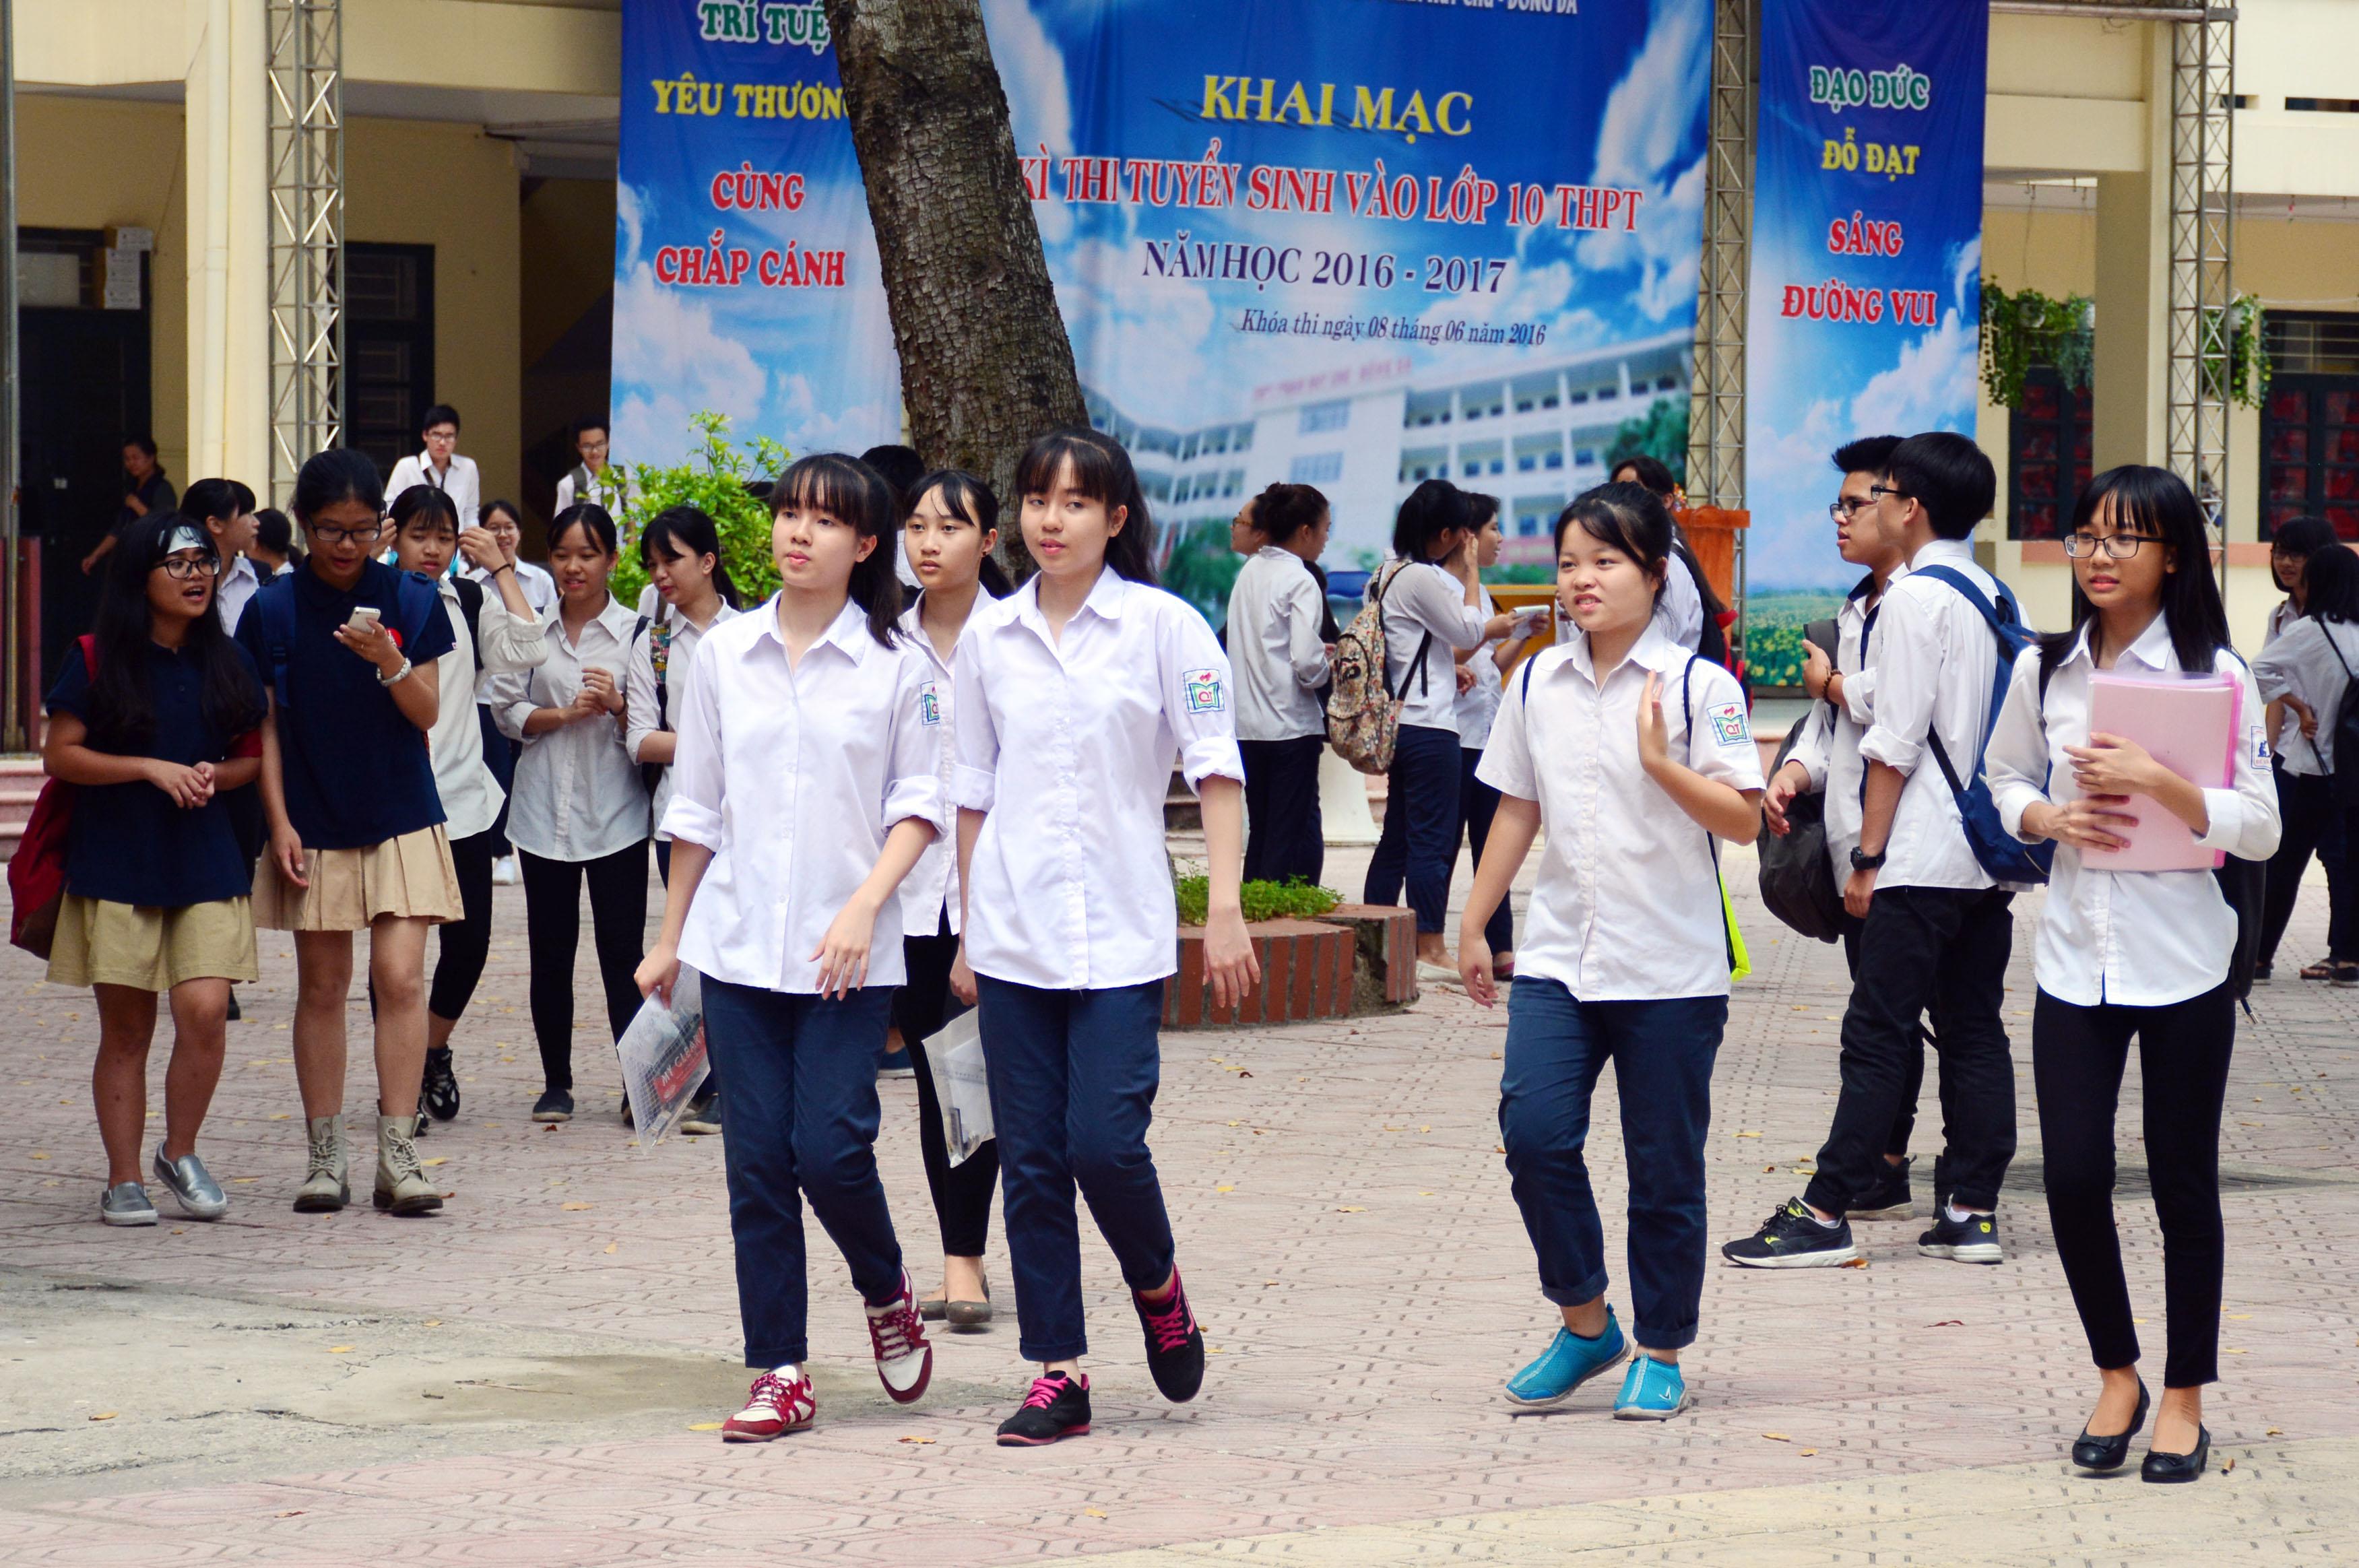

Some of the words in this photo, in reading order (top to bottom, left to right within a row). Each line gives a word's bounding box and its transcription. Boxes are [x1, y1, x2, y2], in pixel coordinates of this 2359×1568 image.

[651, 71, 723, 116] YÊU
[732, 80, 849, 120] THƯƠN
[1200, 75, 1336, 126] KHAI
[1349, 85, 1473, 144] MẠC
[1811, 67, 1866, 112] ĐẠO
[1871, 65, 1929, 109] ĐỨC
[1821, 127, 1859, 171] ĐỖ
[1865, 143, 1920, 182] ĐẠT
[711, 162, 805, 211] CÙNG
[1060, 156, 1120, 202] THI
[1126, 137, 1241, 207] TUYỂN
[1248, 165, 1336, 213] SINH
[1345, 158, 1418, 219] VÀO
[1425, 163, 1498, 224] LỚP
[1507, 183, 1545, 226] 10
[1554, 185, 1644, 232] THPT
[655, 228, 751, 286] CHẮP
[758, 240, 846, 287] CÁNH
[1828, 211, 1904, 257] SÁNG
[1142, 230, 1216, 279] NĂM
[1221, 244, 1301, 291] HỌC
[1312, 251, 1395, 289] 2016
[1424, 257, 1508, 294] 2017
[1781, 279, 1883, 323] ĐƯỜNG
[1889, 289, 1937, 325] VUI
[1241, 308, 1288, 334] Khóa
[1293, 312, 1320, 335] thi
[1322, 314, 1364, 341] ngày
[1368, 316, 1388, 338] 08
[1391, 317, 1442, 346] tháng
[1445, 320, 1466, 342] 06
[1468, 323, 1505, 345] năm
[1508, 323, 1547, 346] 2016
